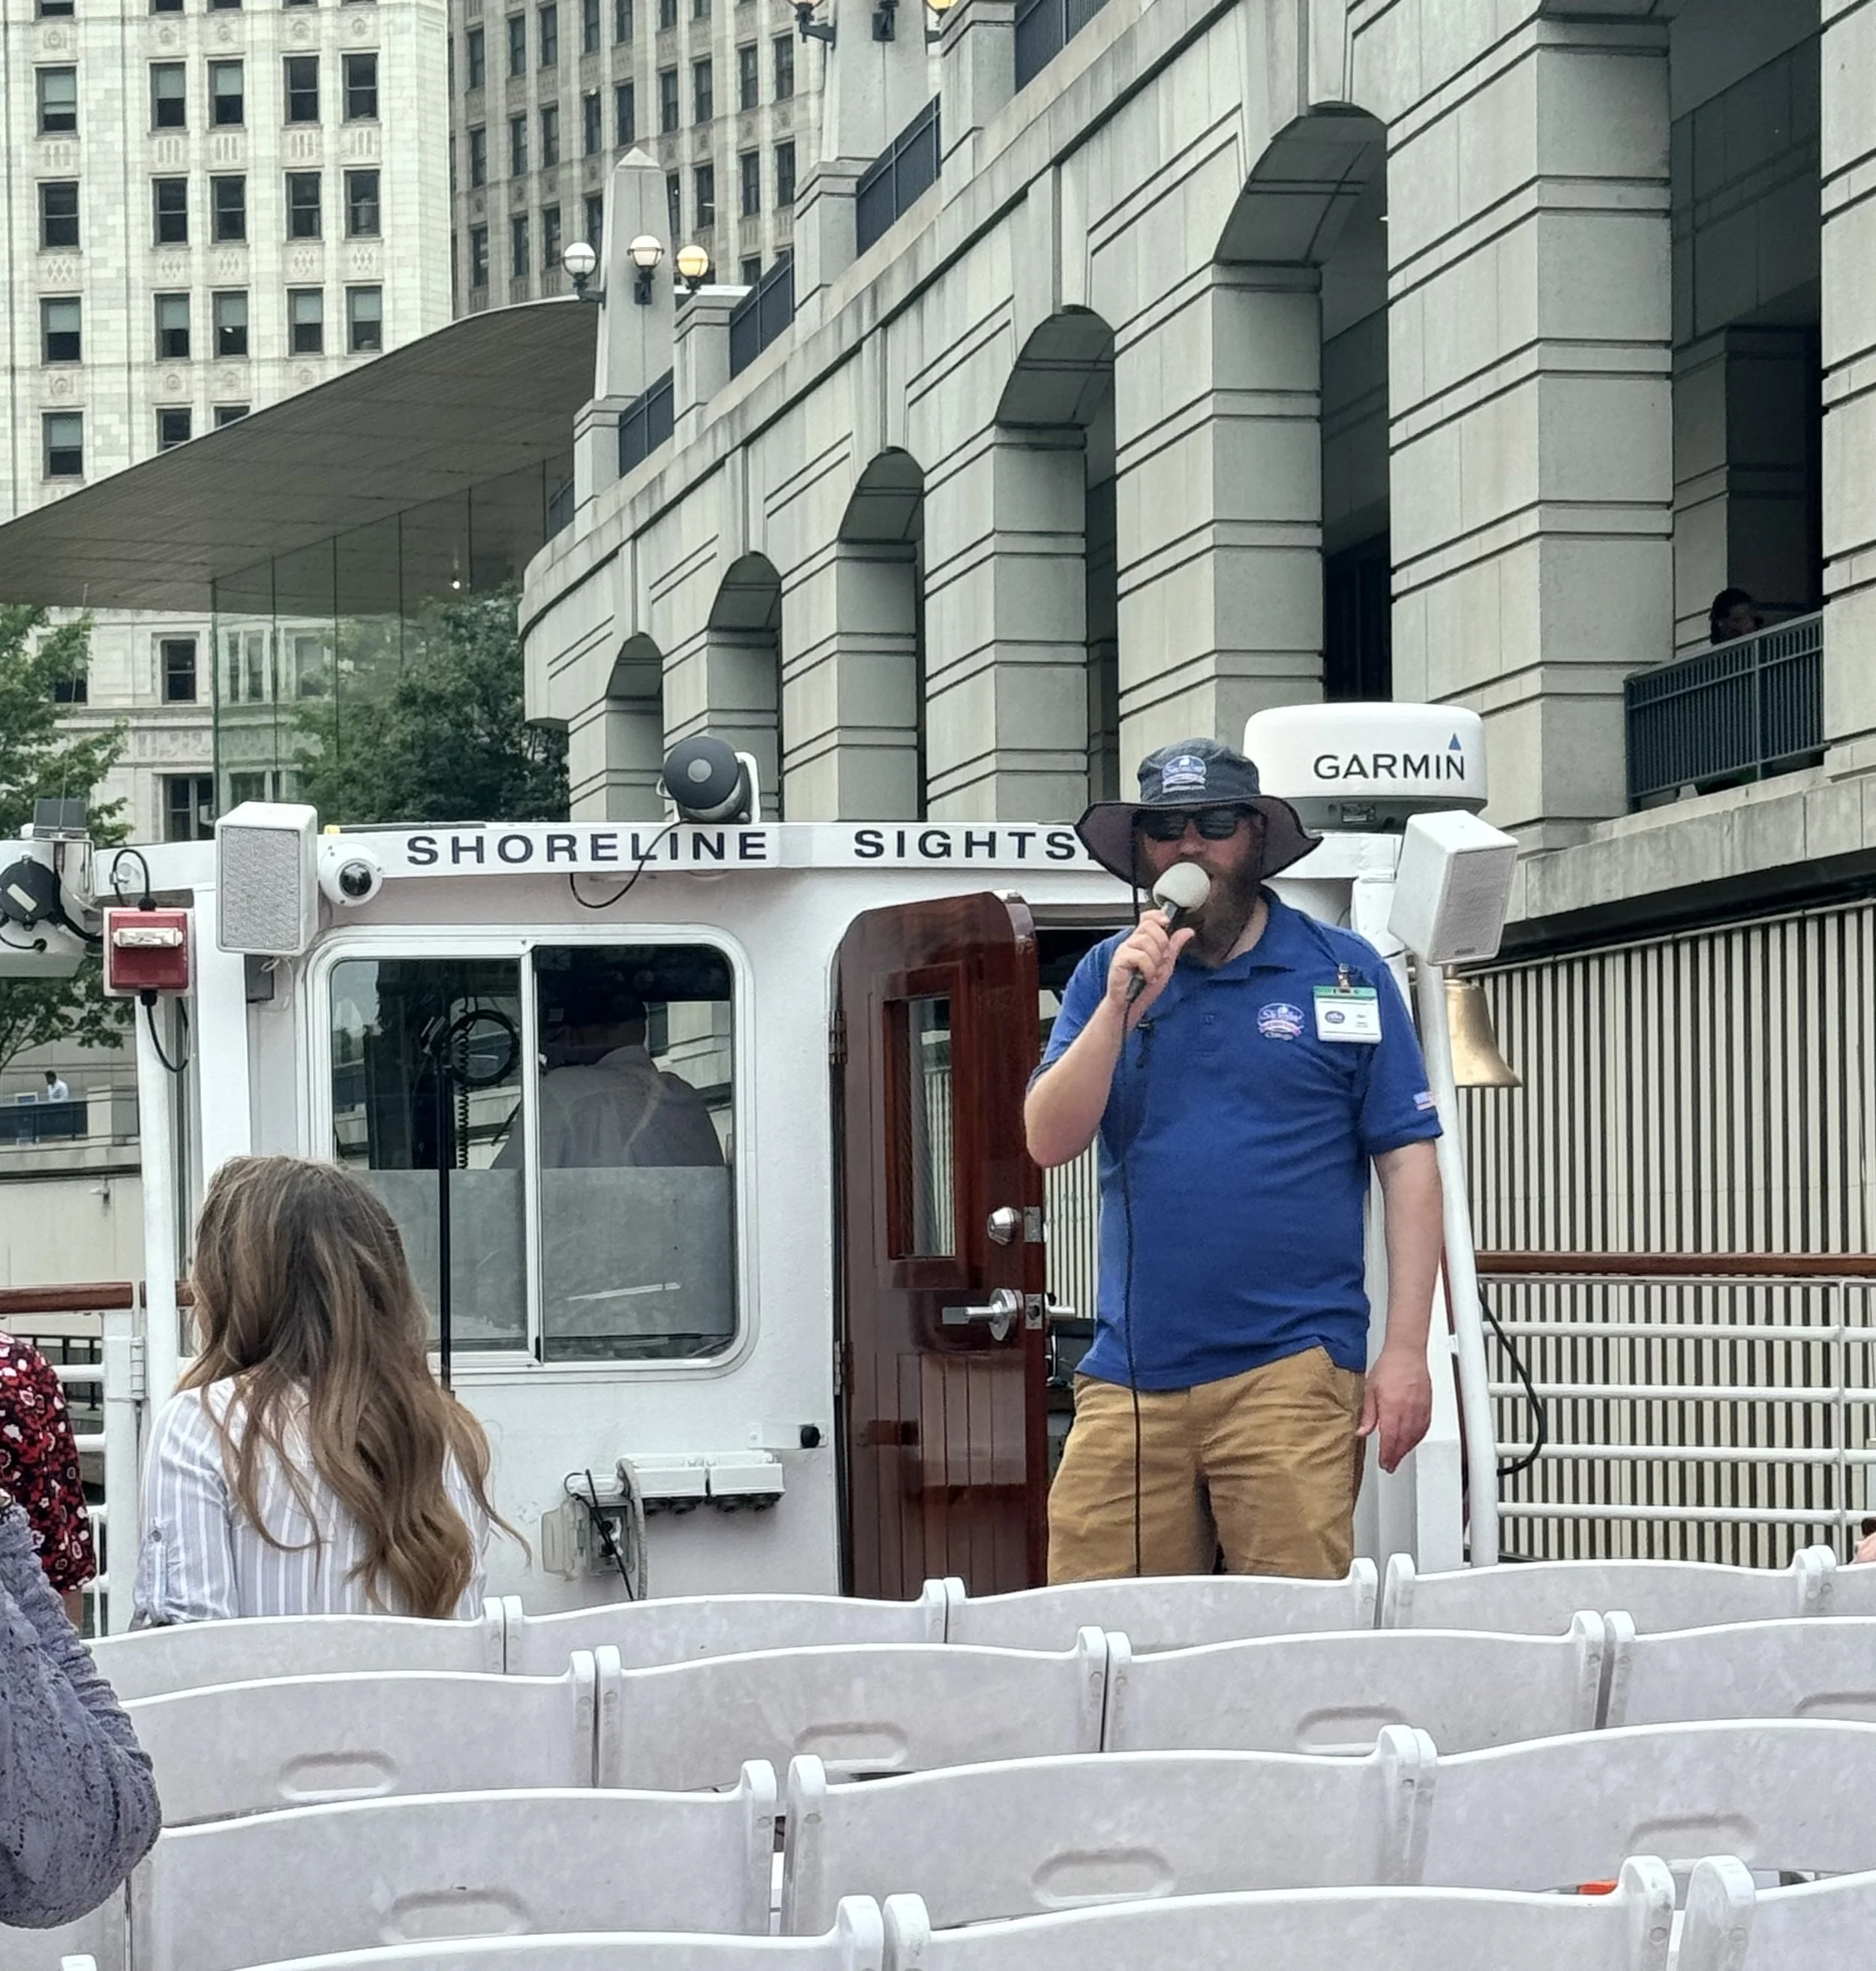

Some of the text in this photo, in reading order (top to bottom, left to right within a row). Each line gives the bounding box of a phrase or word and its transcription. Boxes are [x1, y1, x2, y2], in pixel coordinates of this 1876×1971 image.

[1313, 754, 1465, 781] GARMIN
[406, 829, 1093, 865] SHORELINE SIGHTS
